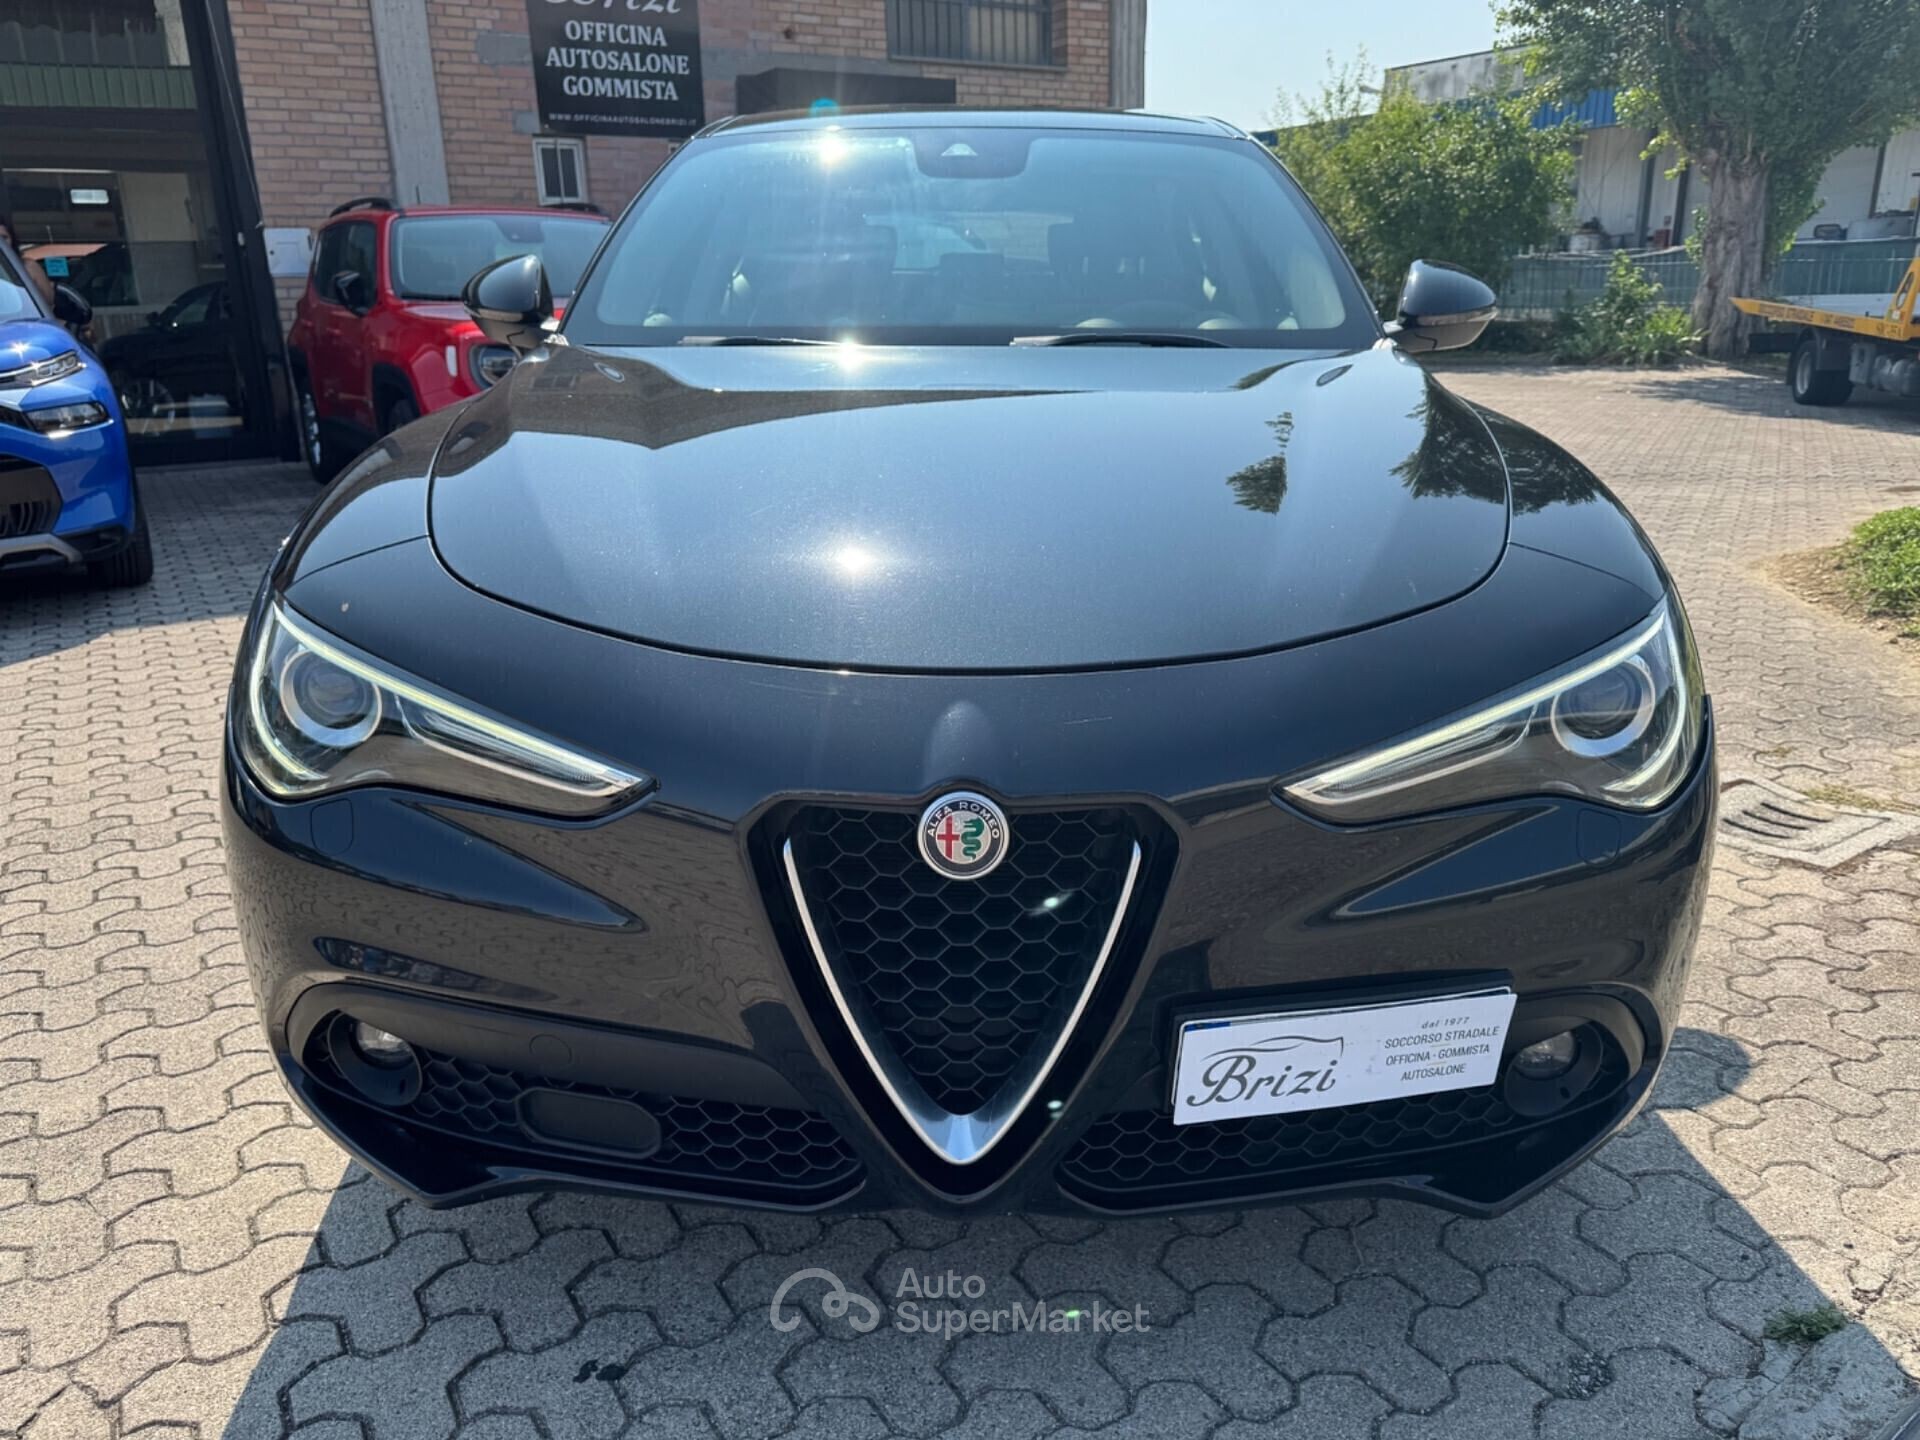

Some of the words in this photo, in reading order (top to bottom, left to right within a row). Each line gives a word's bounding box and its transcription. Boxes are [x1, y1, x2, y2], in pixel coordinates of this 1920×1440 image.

[565, 20, 668, 47] OFFICINA
[545, 47, 690, 75] AUTOSALONE
[563, 75, 679, 101] GOMMISTA
[927, 805, 953, 837] ALFA
[959, 801, 1000, 839] ROMEO
[1444, 1016, 1470, 1027] 1977
[1384, 1032, 1442, 1050] SOCCORSO
[1444, 1026, 1500, 1042] STRADALE
[1385, 1051, 1431, 1067] OFFICINA
[1438, 1043, 1490, 1060] GOMMISTA
[1186, 1055, 1338, 1107] Brizi
[1400, 1062, 1467, 1081] AUTOSALONE
